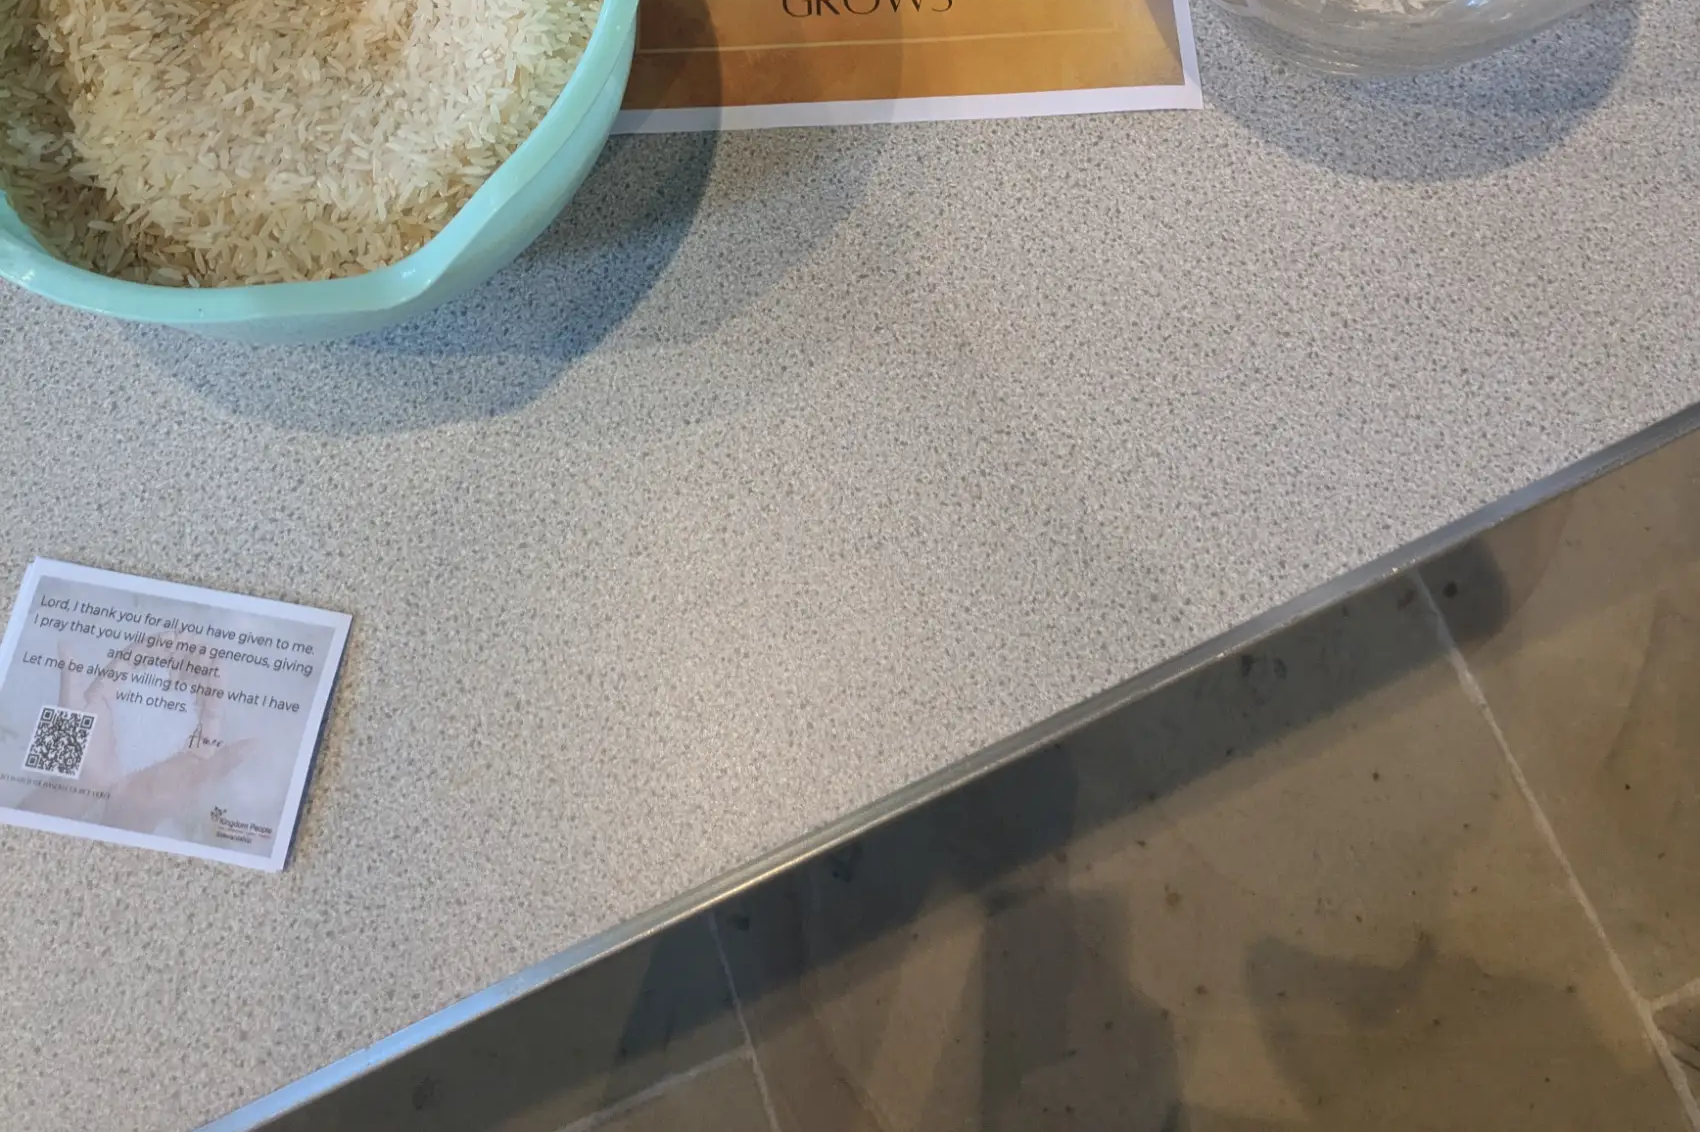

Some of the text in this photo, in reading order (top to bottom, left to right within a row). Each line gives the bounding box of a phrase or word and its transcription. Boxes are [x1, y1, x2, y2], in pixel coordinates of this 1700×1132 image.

[33, 613, 313, 677] I pray that you will give me a generous, giving
[40, 595, 315, 656] Lord, I thank you for all you have given to me.
[22, 652, 300, 713] Let me be always willing to share what I have
[107, 648, 221, 678] and grateful heart.
[116, 690, 188, 713] with others.
